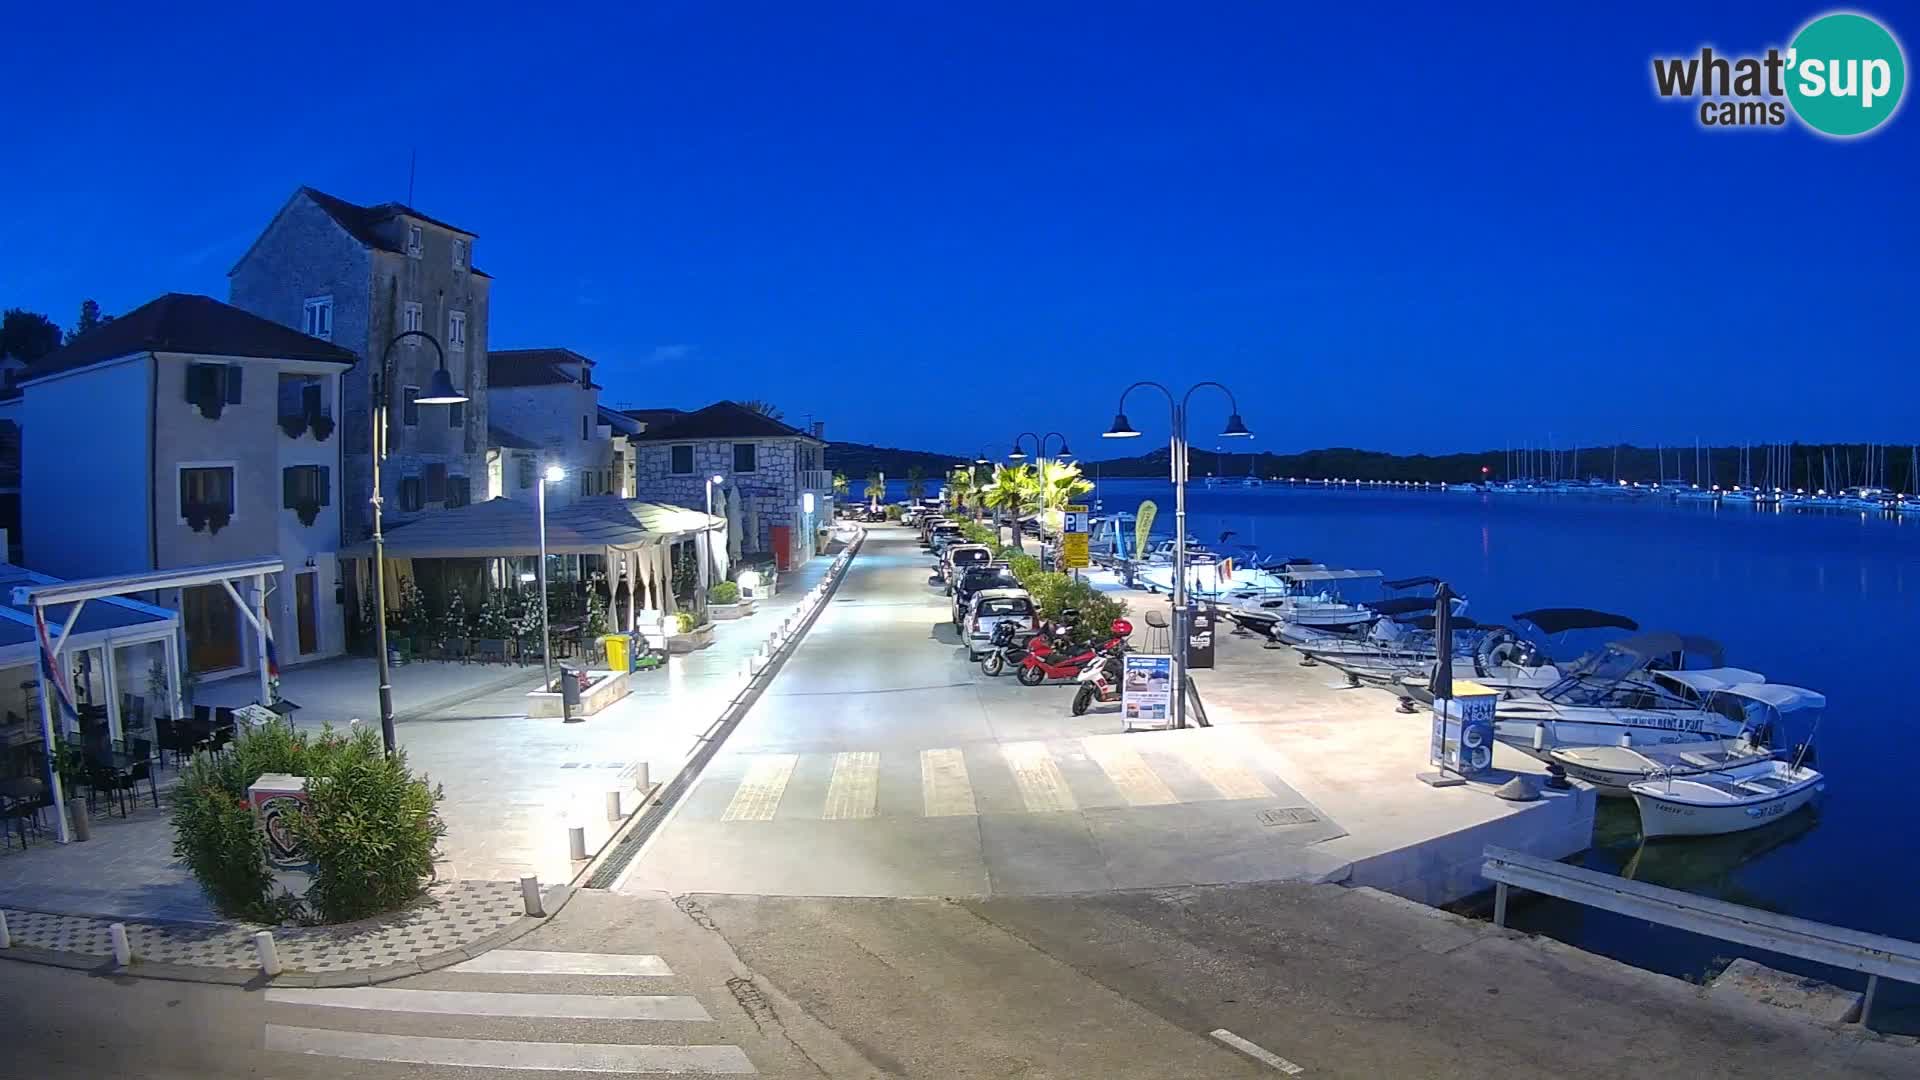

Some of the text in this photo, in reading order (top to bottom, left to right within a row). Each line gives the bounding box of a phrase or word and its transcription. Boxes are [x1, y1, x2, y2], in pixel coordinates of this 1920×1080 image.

[1065, 515, 1075, 531] P
[1464, 701, 1495, 713] RENT
[1471, 712, 1494, 721] BOAT
